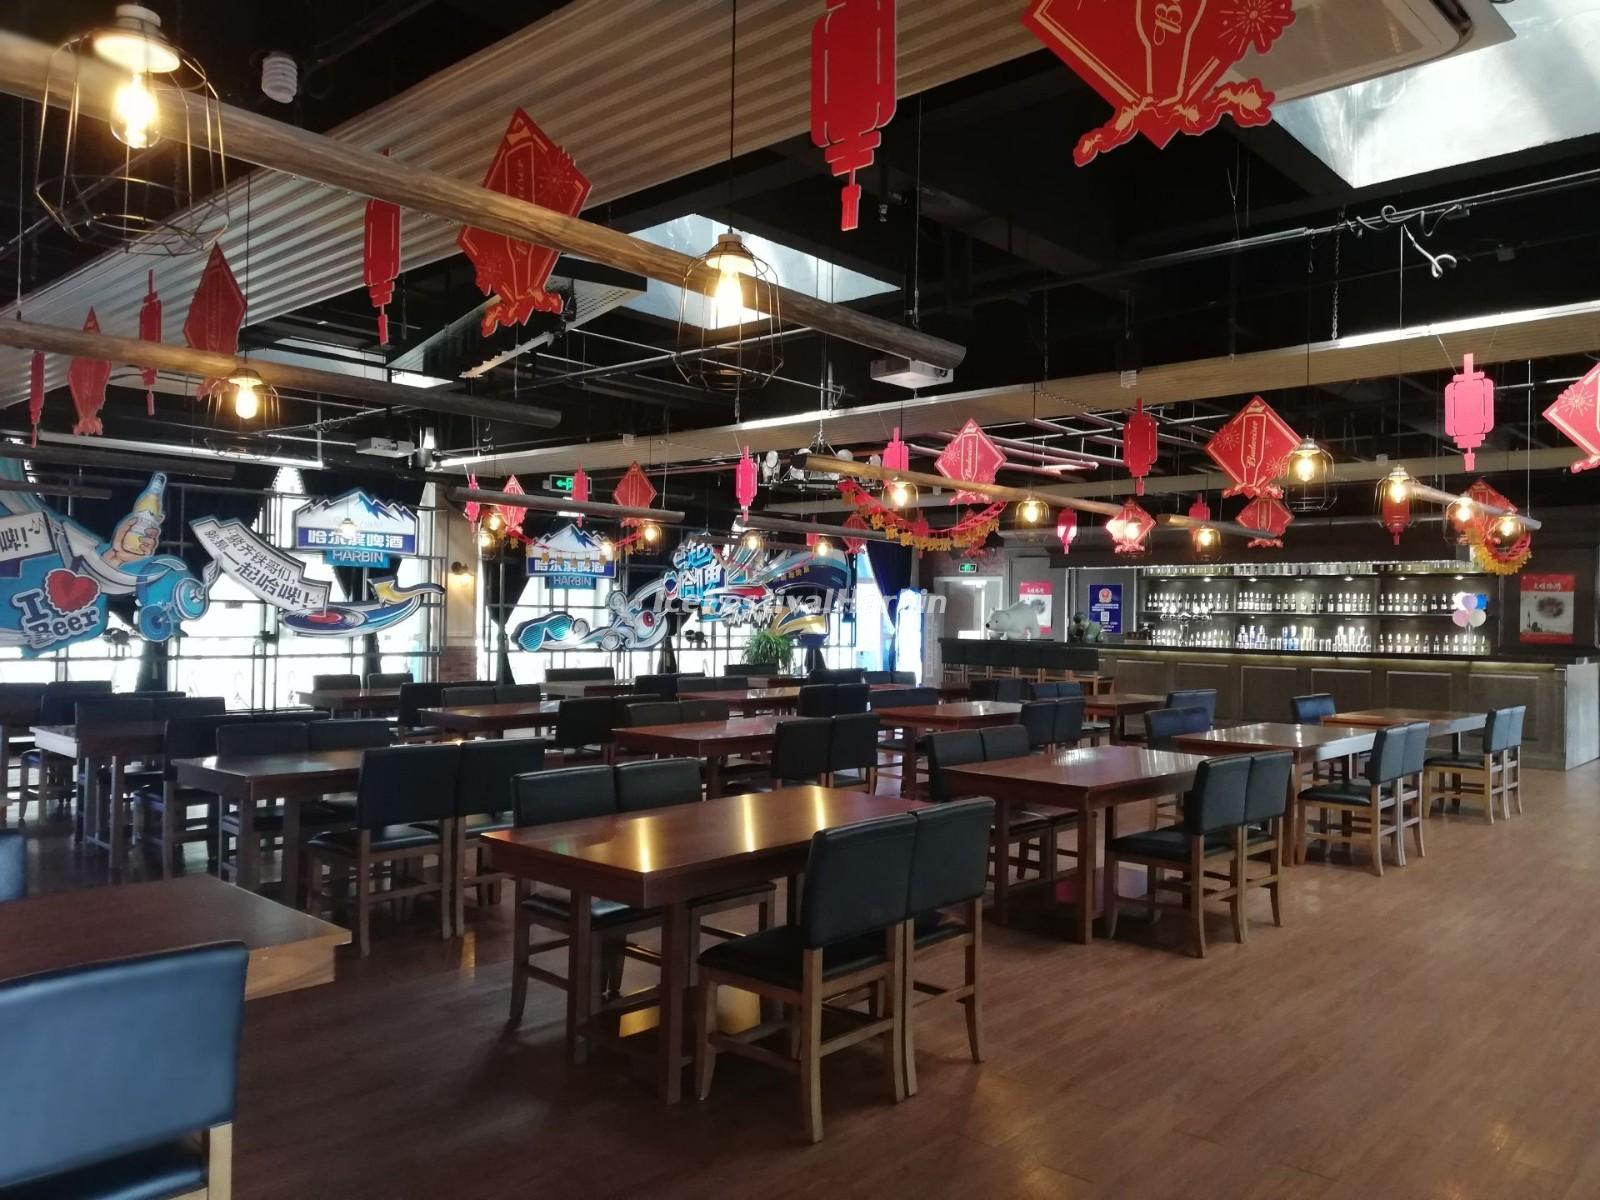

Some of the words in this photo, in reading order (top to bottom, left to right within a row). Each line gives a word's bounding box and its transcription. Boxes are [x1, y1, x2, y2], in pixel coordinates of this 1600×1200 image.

[331, 549, 384, 563] HARBIN
[552, 575, 592, 587] HARBIN
[16, 591, 50, 624] I
[27, 609, 99, 645] Beer
